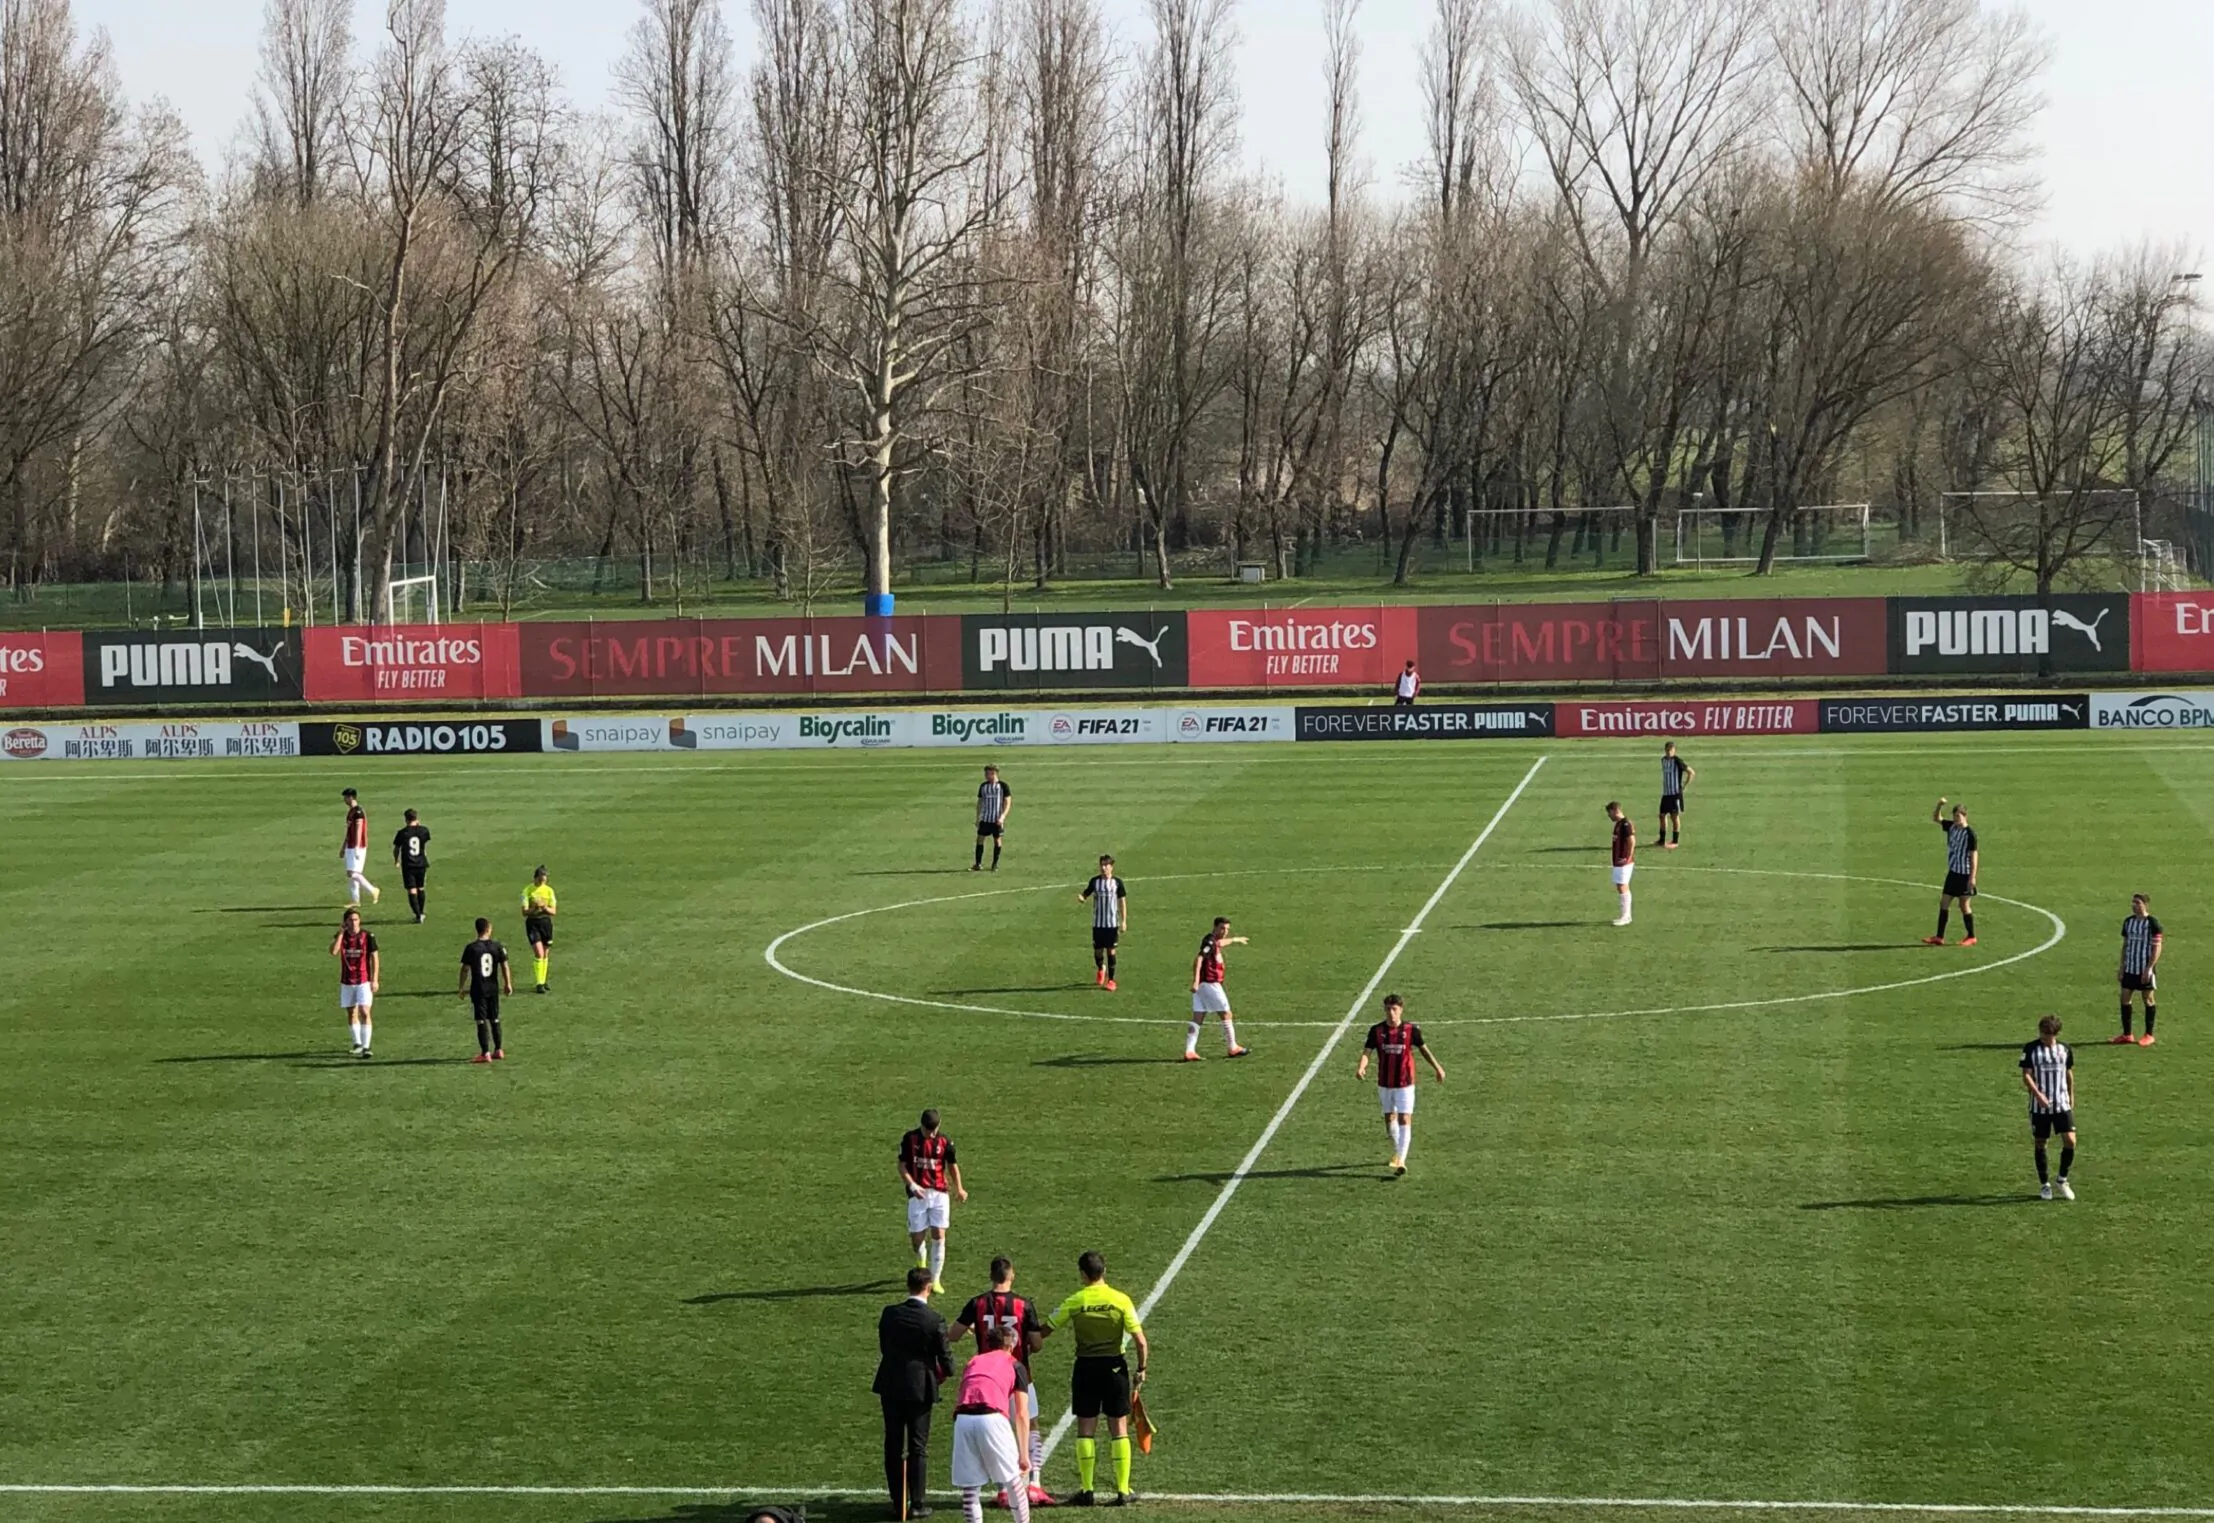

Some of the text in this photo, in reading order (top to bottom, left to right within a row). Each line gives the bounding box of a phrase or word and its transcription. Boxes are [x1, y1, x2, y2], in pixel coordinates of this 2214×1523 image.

[1228, 618, 1377, 651] Emirates
[1450, 616, 1840, 666] SEMPRE MILAN
[1906, 609, 2049, 656] PUMA
[341, 634, 481, 666] Emirates
[550, 633, 918, 680] SEMPRE MILAN
[979, 626, 1113, 671] PUMA
[101, 642, 231, 687] PUMA
[1267, 655, 1339, 675] FLY BETTER
[378, 669, 446, 689] FLY BETTER
[1304, 714, 1391, 732] FOREVER
[1474, 712, 1526, 729] PUMA
[1580, 706, 1794, 731] Emirates FLY BETTER
[1828, 705, 1918, 724] FOREVER
[2004, 703, 2058, 721] PUMA
[2098, 709, 2174, 726] BANCO
[80, 726, 118, 738] ALPS
[160, 725, 198, 738] ALPS
[240, 724, 279, 737] ALPS
[586, 724, 662, 744] snaipay
[703, 722, 780, 742] snaipay
[800, 715, 890, 744] Bioscalin
[932, 713, 1024, 742] Bioscalin
[1078, 719, 1118, 734] FIFA
[1120, 719, 1139, 734] 21
[1206, 717, 1246, 732] FIFA
[1248, 716, 1267, 731] 21
[4, 736, 46, 750] Beretta
[65, 739, 133, 757] 阿尔卑斯
[145, 738, 214, 757] 阿尔卑斯
[226, 736, 294, 756] 阿尔卑斯
[336, 731, 357, 745] 105
[366, 725, 507, 751] RADIO 105
[409, 836, 420, 856] 9
[481, 953, 493, 977] 8
[1081, 1304, 1115, 1313] LEGEA
